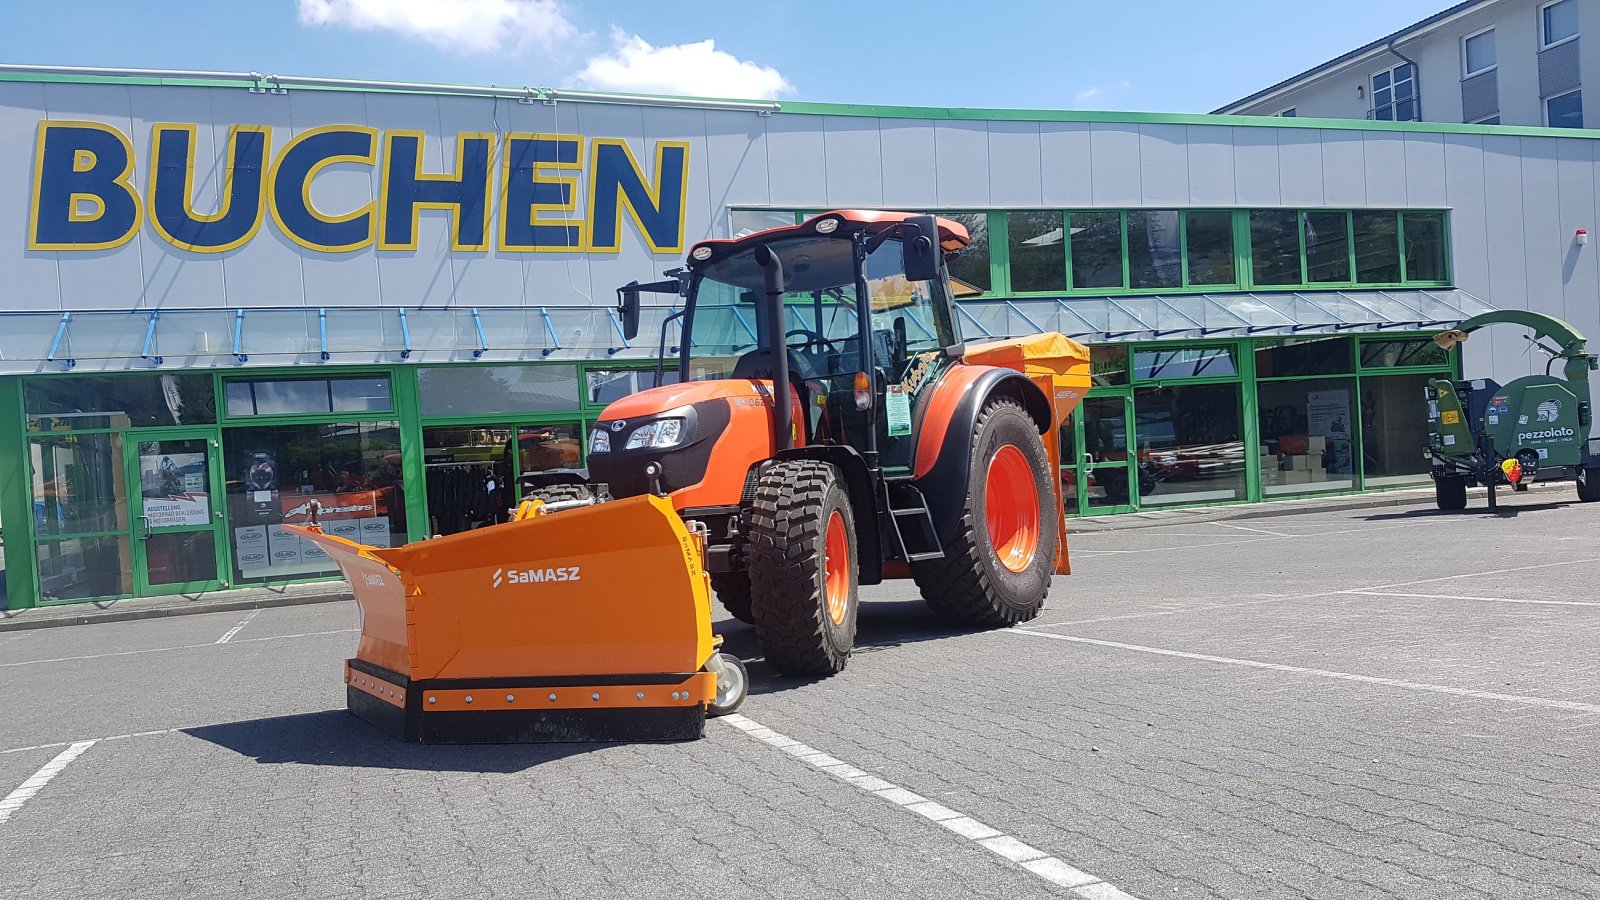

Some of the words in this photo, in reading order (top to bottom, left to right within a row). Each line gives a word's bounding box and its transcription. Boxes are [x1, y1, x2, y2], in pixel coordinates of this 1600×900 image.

[28, 120, 690, 254] BUCHEN
[900, 352, 933, 394] Kubota
[1518, 426, 1574, 446] pezzolato
[507, 566, 581, 584] SaMASZ
